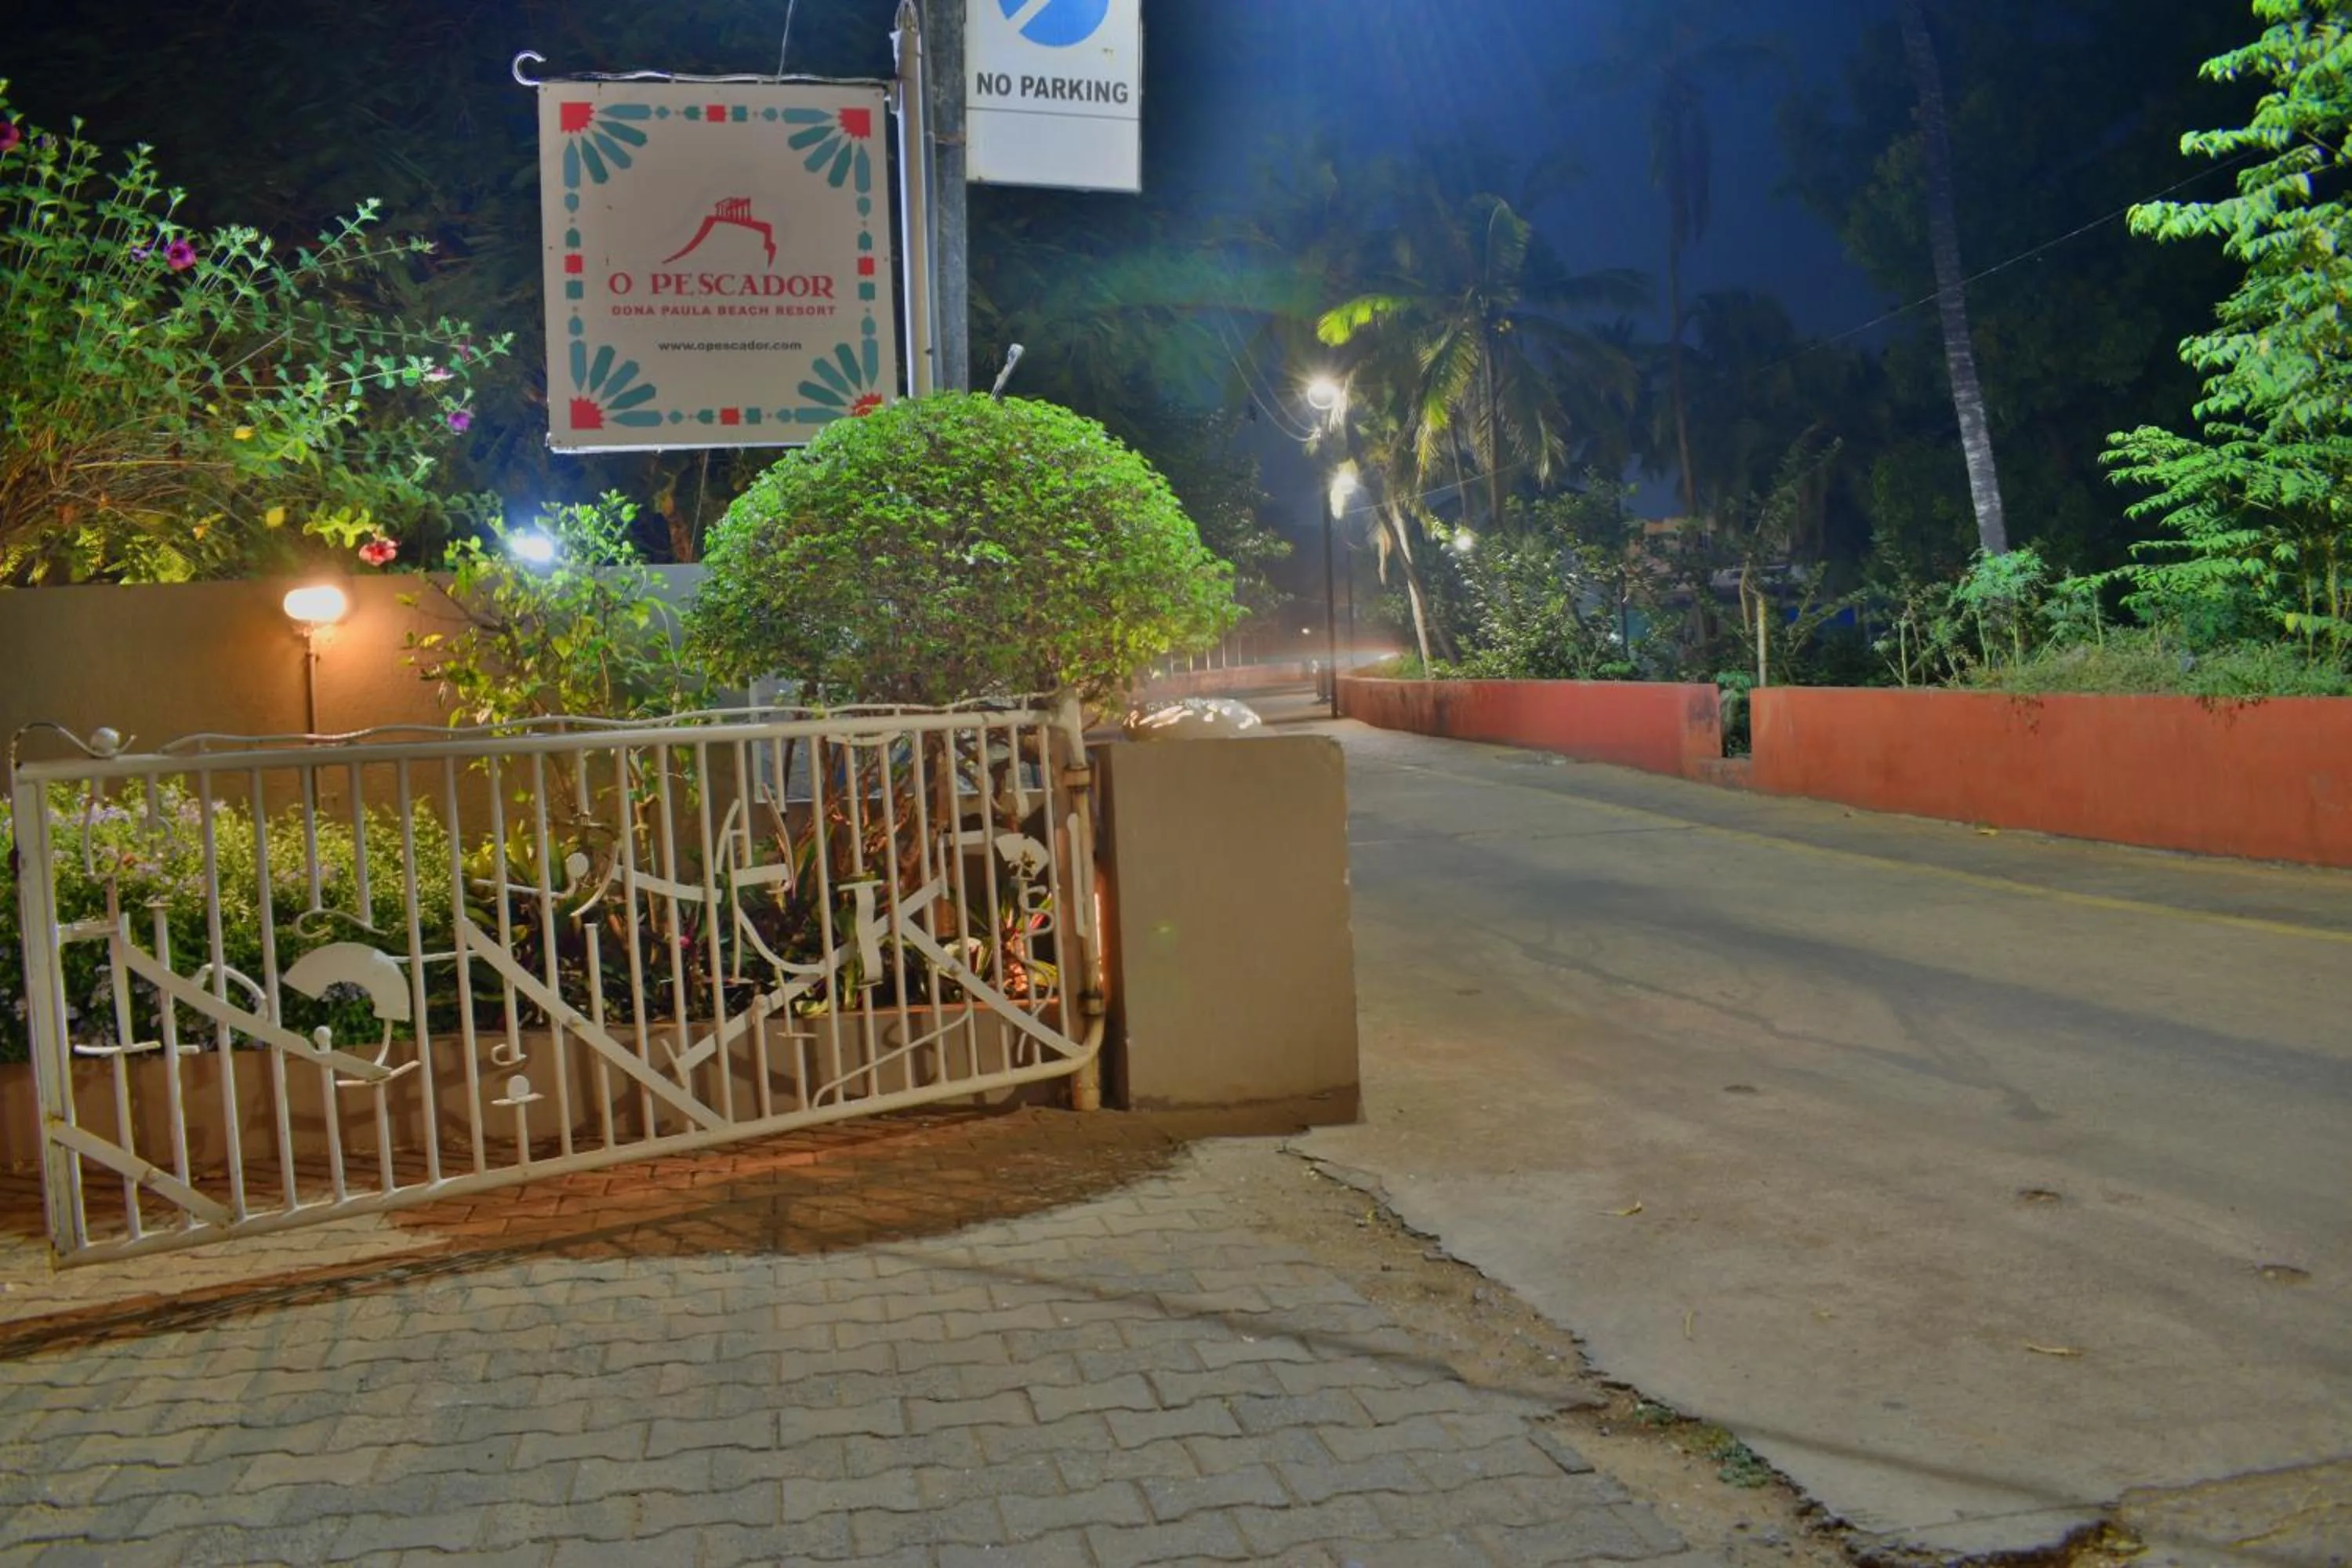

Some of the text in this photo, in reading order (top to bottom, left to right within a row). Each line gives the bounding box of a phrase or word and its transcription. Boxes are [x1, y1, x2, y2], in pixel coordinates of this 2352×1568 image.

[976, 71, 1129, 104] NO PARKING
[608, 271, 837, 299] O PESCADOR
[612, 305, 836, 316] DONA PAULA BEACH RESORT
[658, 339, 802, 352] www.opescador.com
